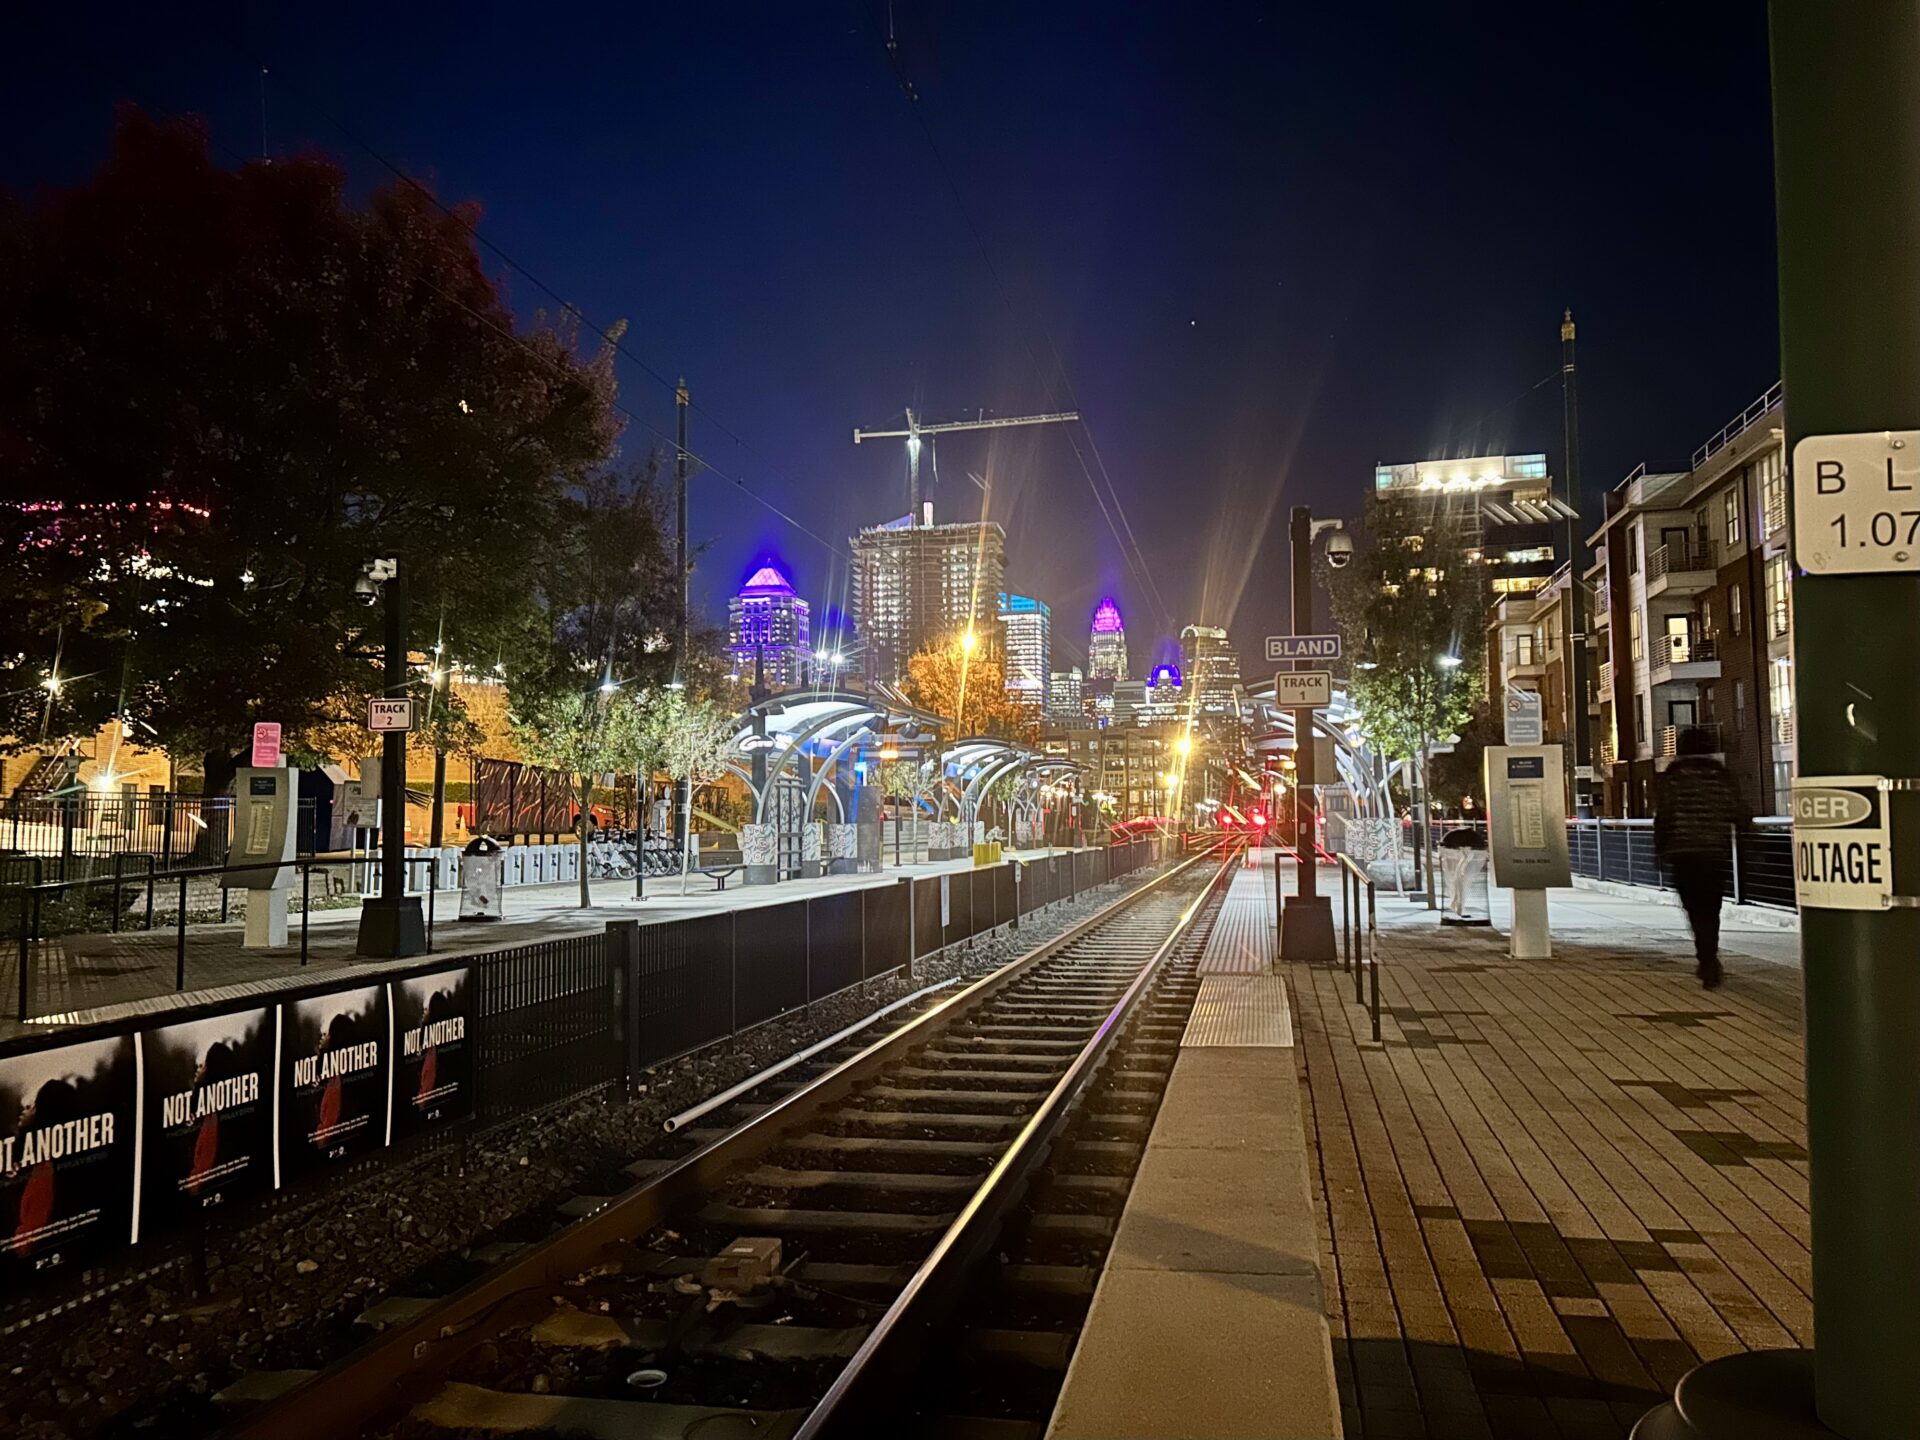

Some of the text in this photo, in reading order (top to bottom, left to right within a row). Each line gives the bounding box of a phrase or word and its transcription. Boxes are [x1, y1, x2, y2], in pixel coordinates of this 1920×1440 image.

[1816, 457, 1912, 495] B L
[1831, 511, 1920, 548] 1.07
[1270, 640, 1336, 656] BLAND
[1283, 677, 1322, 688] TRACK
[1299, 691, 1306, 701] 1
[374, 704, 406, 714] TRACK
[386, 716, 393, 726] 2
[1795, 796, 1850, 819] GER
[1796, 841, 1882, 885] OLTAGE
[404, 1016, 465, 1056] NOT ANOTHER
[293, 1040, 378, 1088] NOT ANOTHER
[162, 1071, 260, 1129] NOT ANOTHER
[20, 1111, 115, 1168] ANOTHER
